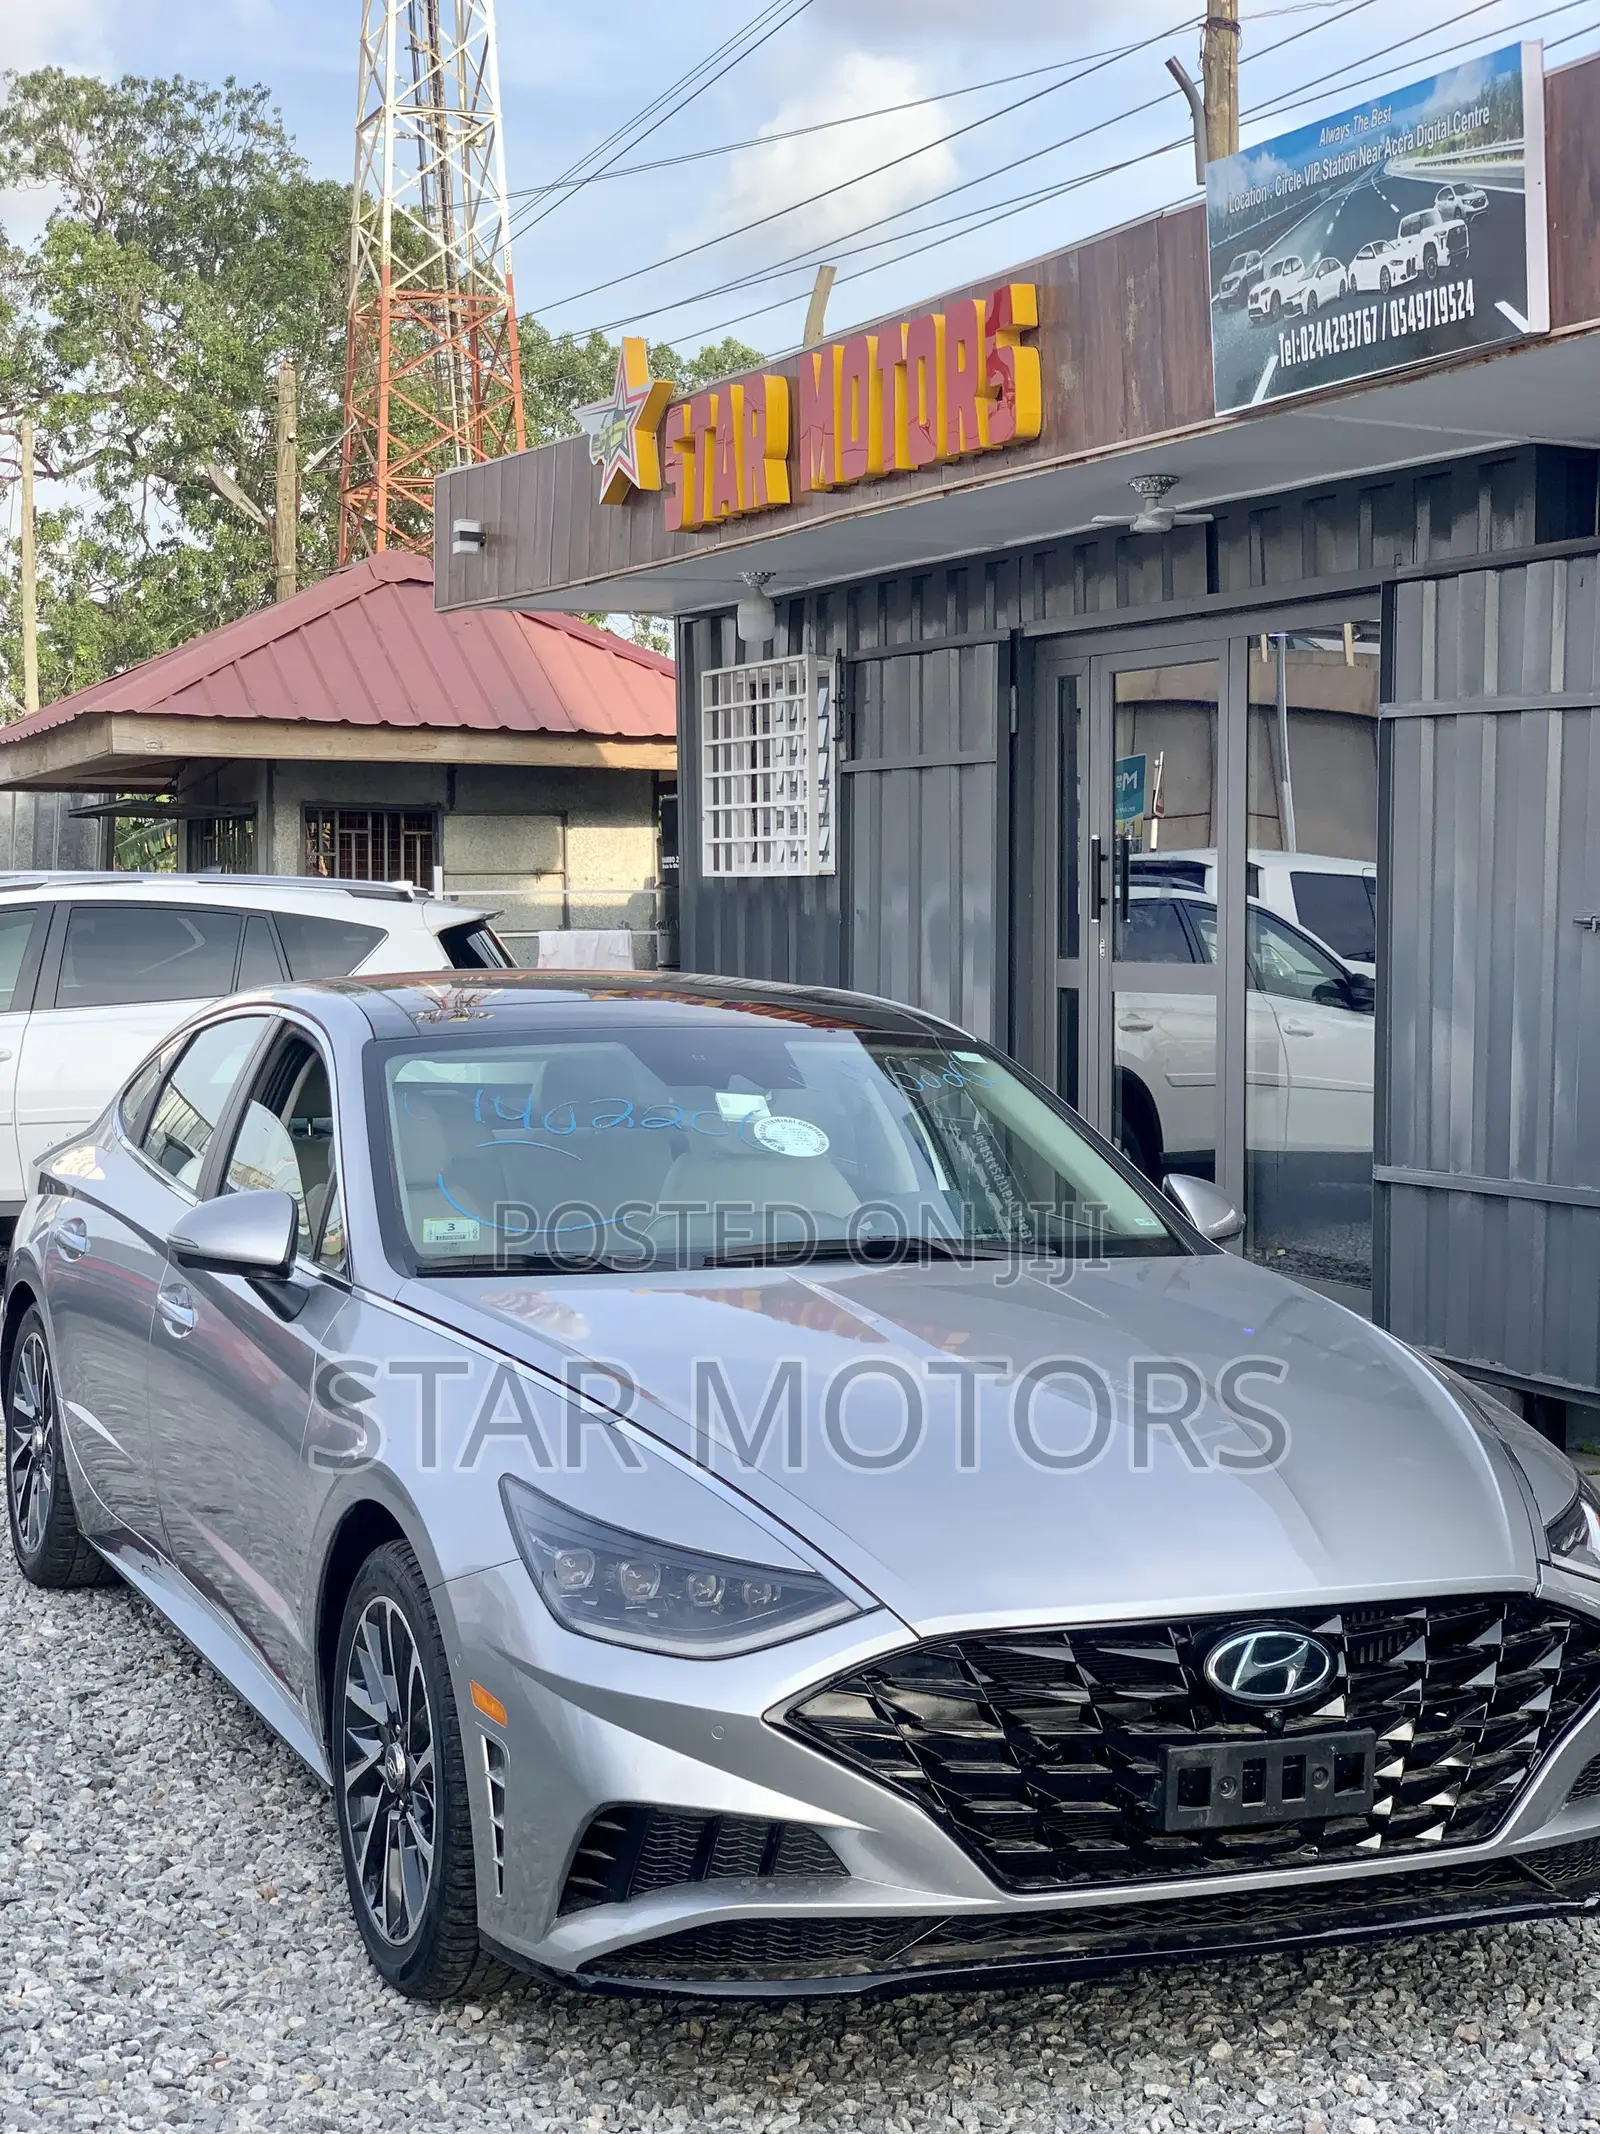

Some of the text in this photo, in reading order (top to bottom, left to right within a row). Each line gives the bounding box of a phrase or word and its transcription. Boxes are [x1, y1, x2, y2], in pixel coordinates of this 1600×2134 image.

[1228, 185, 1268, 214] Location
[1275, 170, 1302, 197] Circle
[1303, 161, 1320, 187] VIP
[1322, 151, 1358, 181] Station
[1359, 143, 1383, 167] Near
[1384, 133, 1414, 160] Accra
[1416, 115, 1450, 149] Digital
[1453, 106, 1490, 133] Centre
[1319, 104, 1392, 147] Always The Best
[1278, 305, 1378, 368] Tel:0244293767
[1389, 278, 1475, 338] 0549719524
[665, 283, 1041, 533] STAR MOTORS
[447, 1222, 456, 1232] 3
